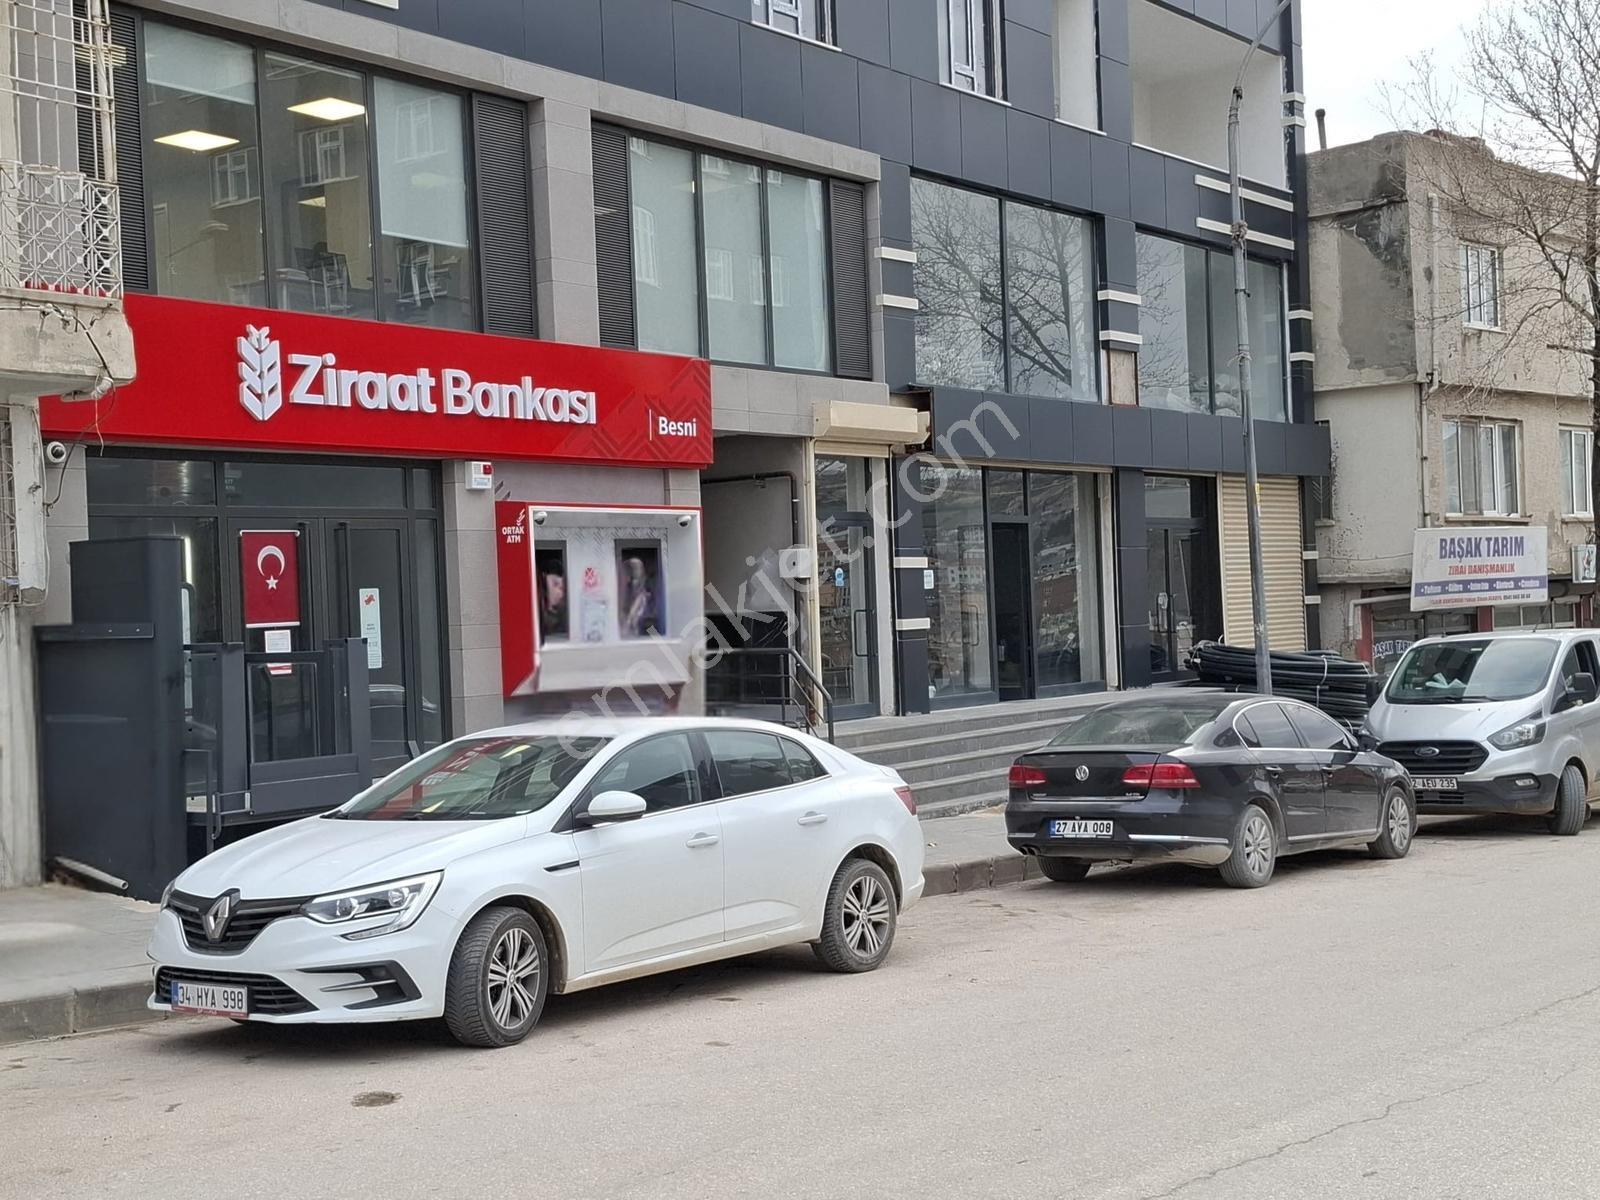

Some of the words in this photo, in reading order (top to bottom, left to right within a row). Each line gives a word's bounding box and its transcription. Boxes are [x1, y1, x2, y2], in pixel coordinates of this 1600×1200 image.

[288, 351, 437, 413] Ziraat
[442, 368, 597, 424] Bankası
[658, 415, 697, 438] Besni
[502, 526, 525, 535] ORTAK
[507, 535, 521, 544] ATM
[1439, 537, 1482, 562] BAŞAK
[1485, 536, 1525, 558] TARIM
[1439, 778, 1455, 788] 235
[1056, 821, 1068, 833] 27
[1071, 821, 1088, 833] AVA
[1092, 822, 1112, 834] 008
[178, 985, 191, 1005] 34
[196, 986, 217, 1008] HYA
[222, 989, 244, 1010] 998
